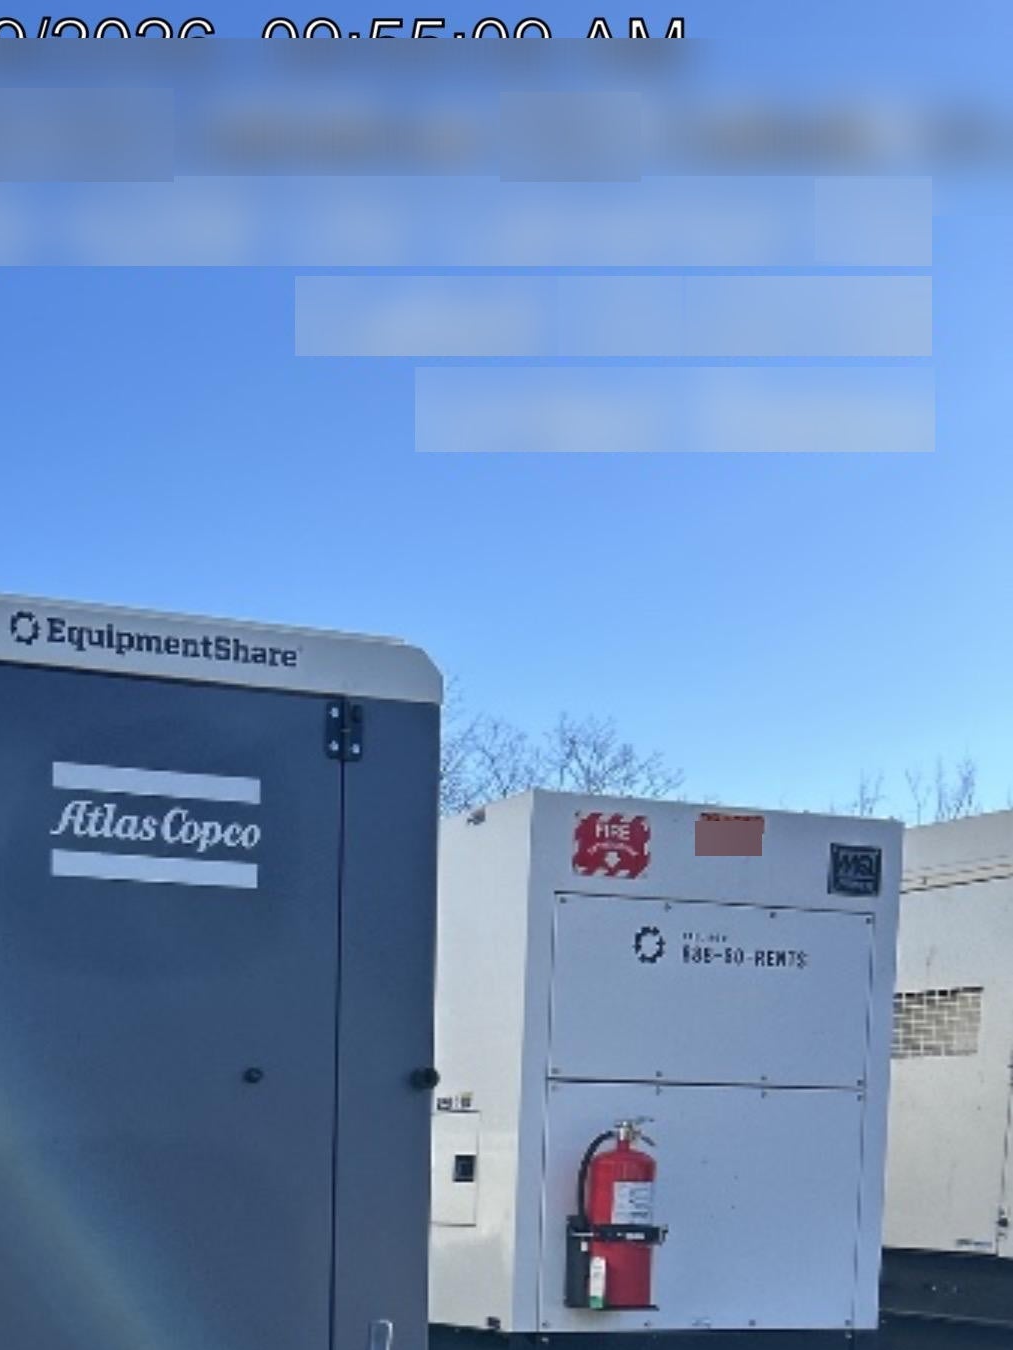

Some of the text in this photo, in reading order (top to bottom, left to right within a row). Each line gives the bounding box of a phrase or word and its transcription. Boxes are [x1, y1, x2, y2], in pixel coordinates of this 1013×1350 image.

[46, 617, 298, 667] EquipmentShare
[49, 800, 261, 853] Atlas Copco
